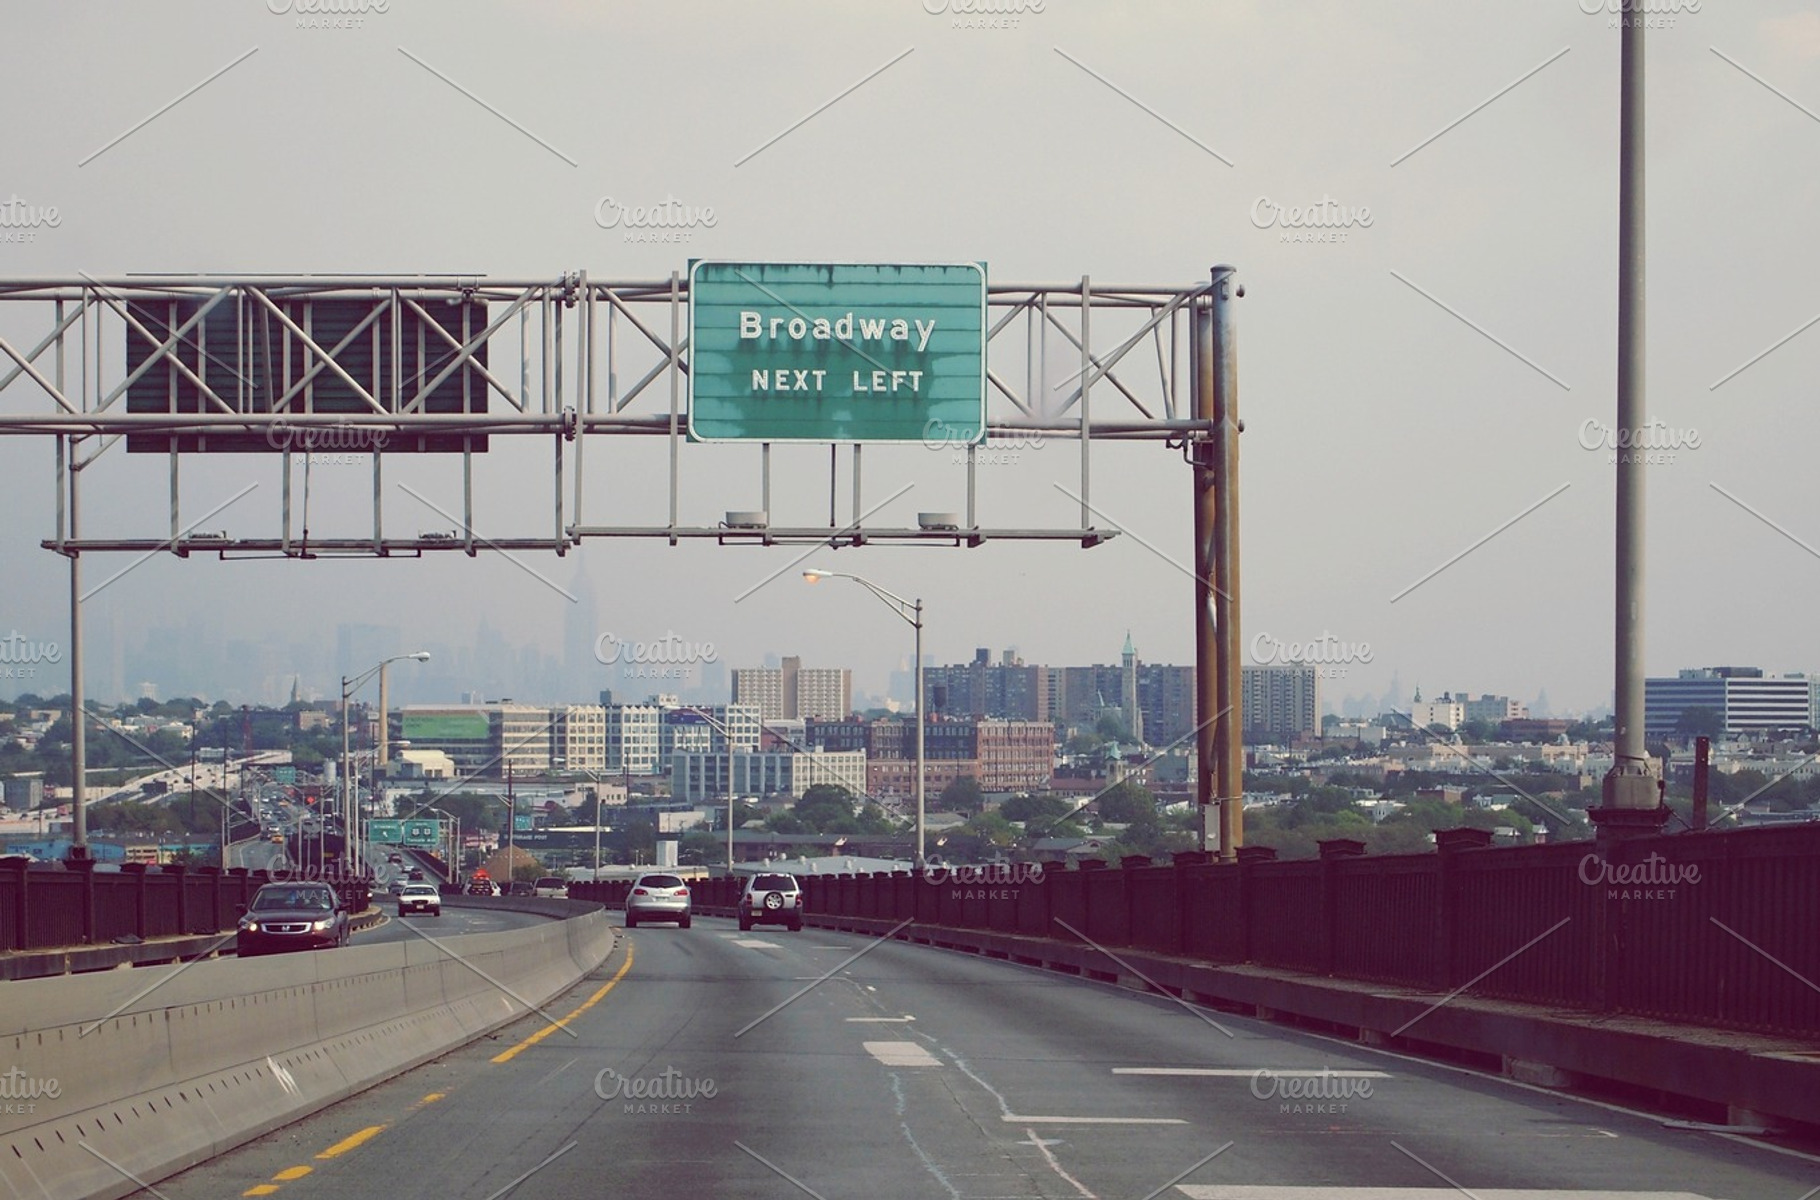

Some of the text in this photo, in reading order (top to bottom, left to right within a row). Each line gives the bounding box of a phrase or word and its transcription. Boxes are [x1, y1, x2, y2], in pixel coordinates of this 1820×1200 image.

[740, 311, 935, 352] Broadway
[752, 369, 923, 392] NEXT LEFT
